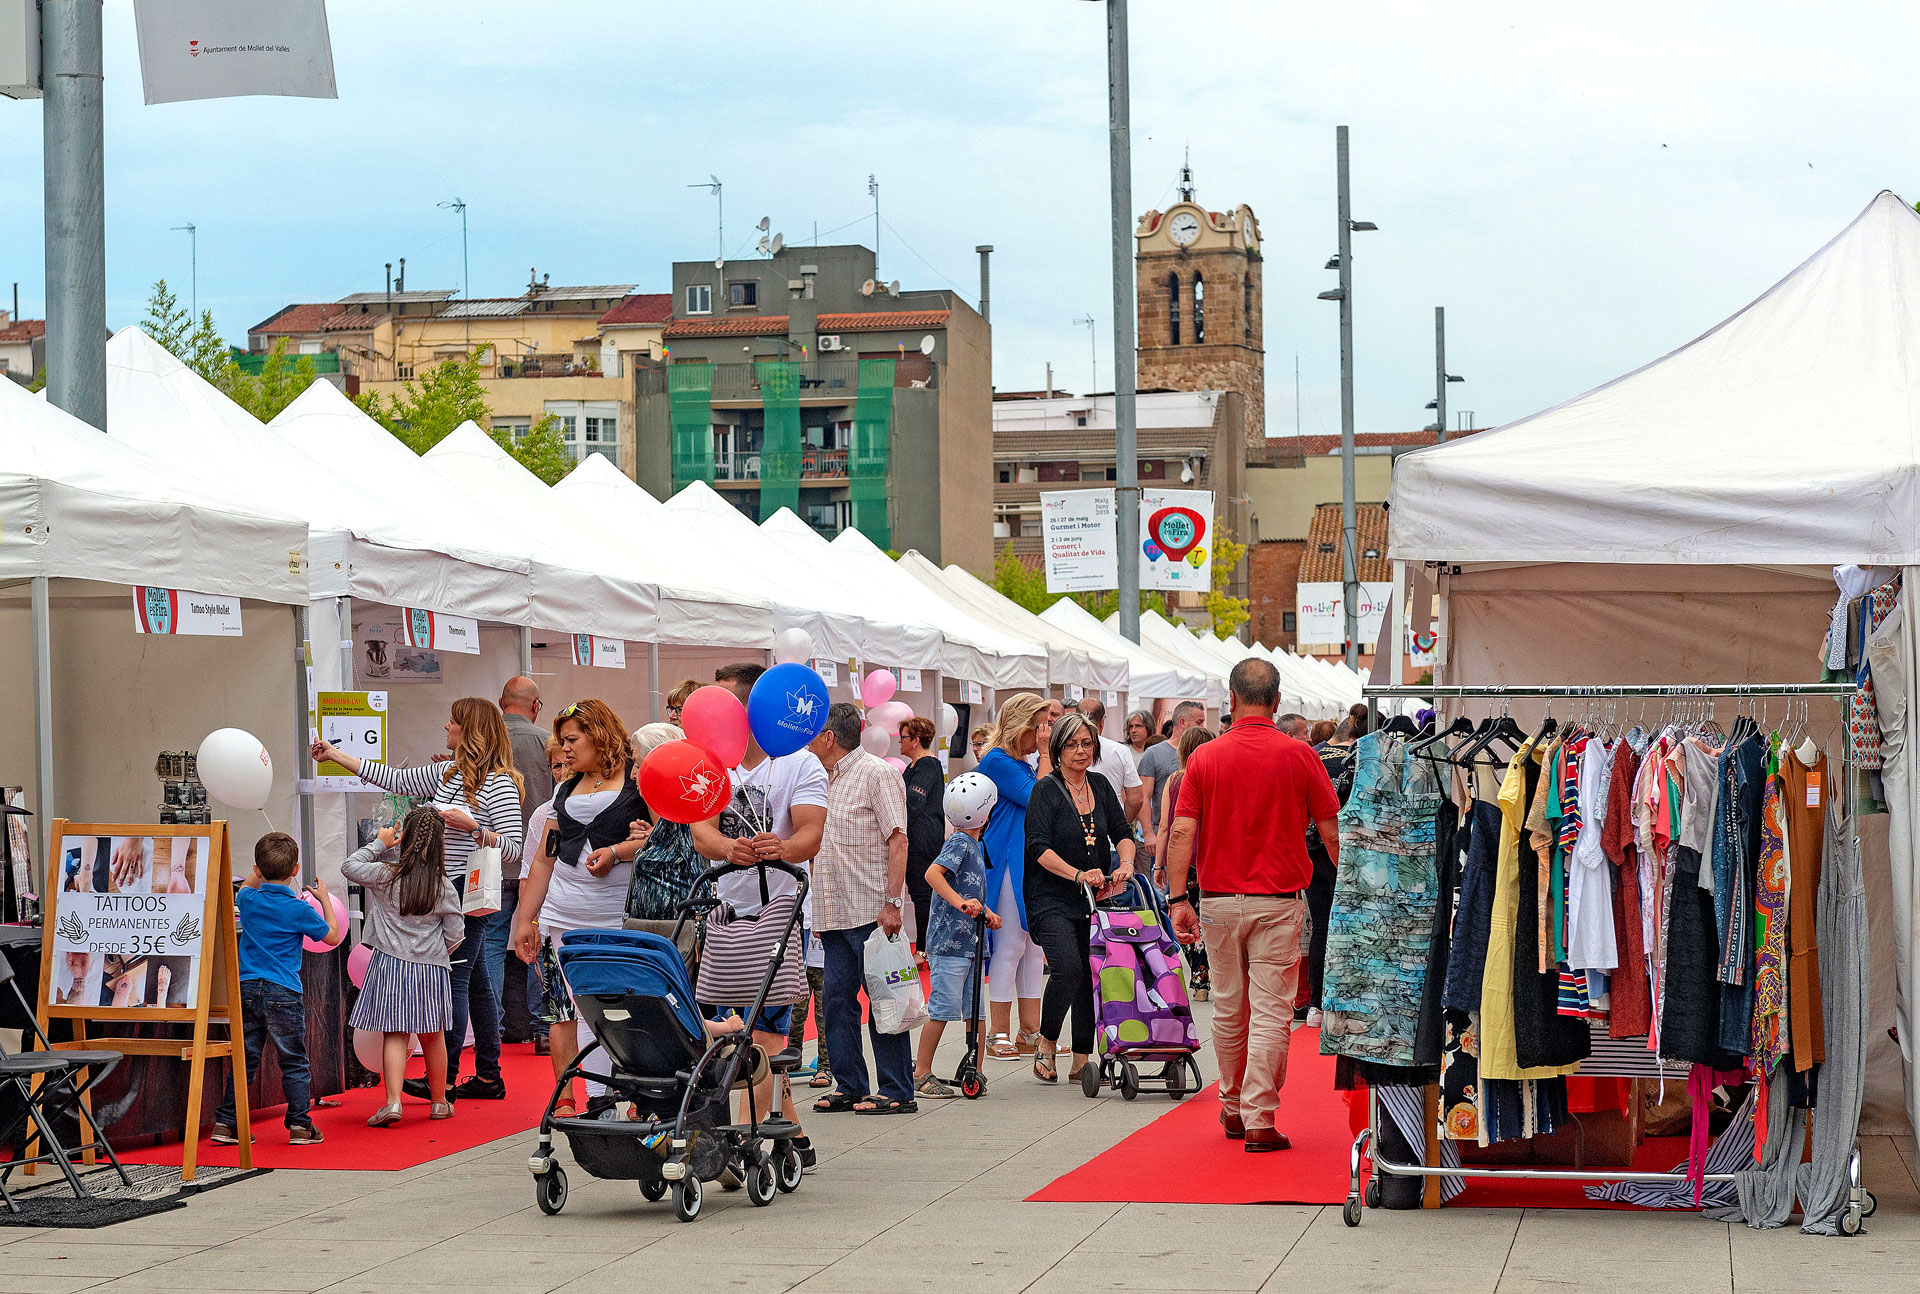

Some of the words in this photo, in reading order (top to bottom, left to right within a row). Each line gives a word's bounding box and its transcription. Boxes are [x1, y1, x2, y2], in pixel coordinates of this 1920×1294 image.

[203, 45, 237, 54] Ajuntament
[247, 44, 264, 52] Mollet
[1050, 523, 1077, 531] Gurmet
[1163, 521, 1190, 530] Mollet
[1051, 543, 1077, 551] Comerç
[1052, 551, 1080, 559] Qualitat
[147, 588, 167, 602] Mollet
[190, 603, 205, 614] Tattoo
[205, 603, 216, 616] Style
[216, 604, 231, 615] Mollet
[796, 697, 813, 716] M
[350, 732, 353, 742] i
[364, 730, 378, 744] G
[690, 773, 711, 796] M
[94, 896, 167, 912] TATTOOS
[88, 917, 170, 930] PERMANENTES
[89, 942, 126, 953] DESDE
[130, 935, 166, 954] 35€
